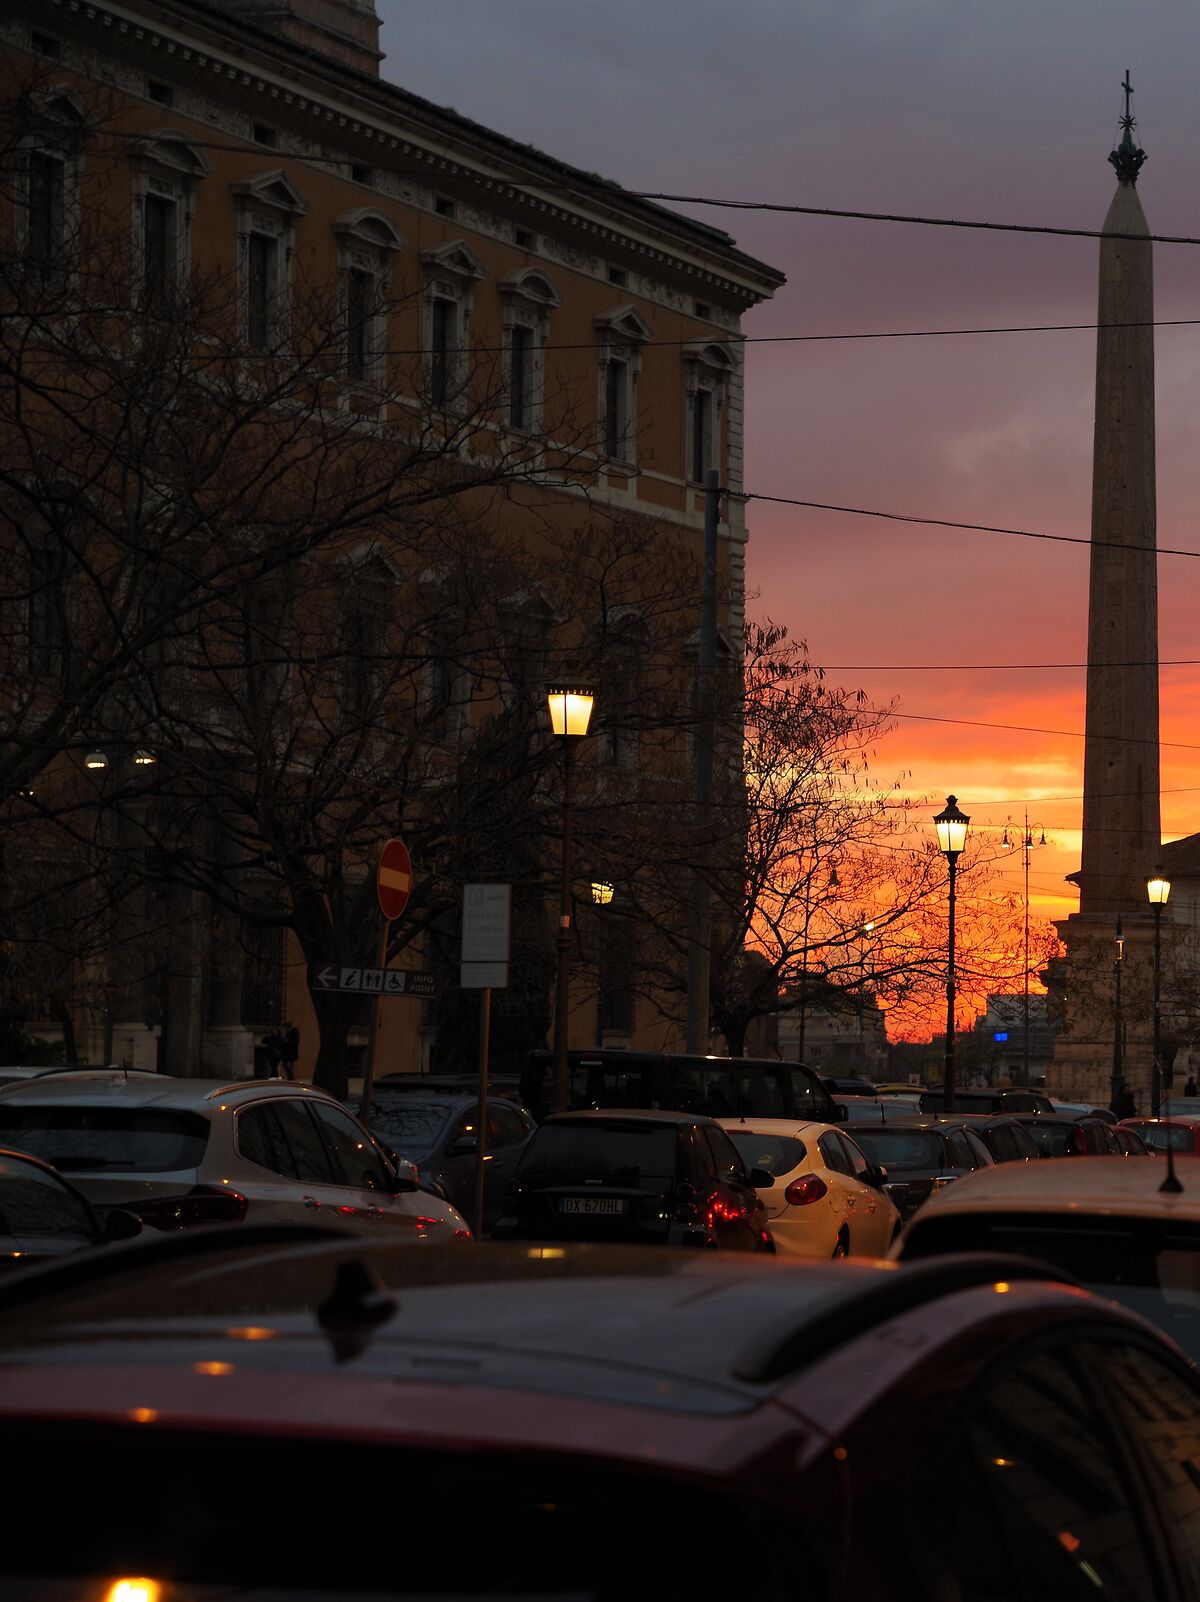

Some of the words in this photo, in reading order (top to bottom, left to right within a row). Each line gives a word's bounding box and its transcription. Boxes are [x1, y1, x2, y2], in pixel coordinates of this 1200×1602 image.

[414, 975, 434, 984] INFO
[409, 984, 436, 993] POINT
[566, 1199, 580, 1212] DX
[584, 1199, 621, 1213] 670HL
